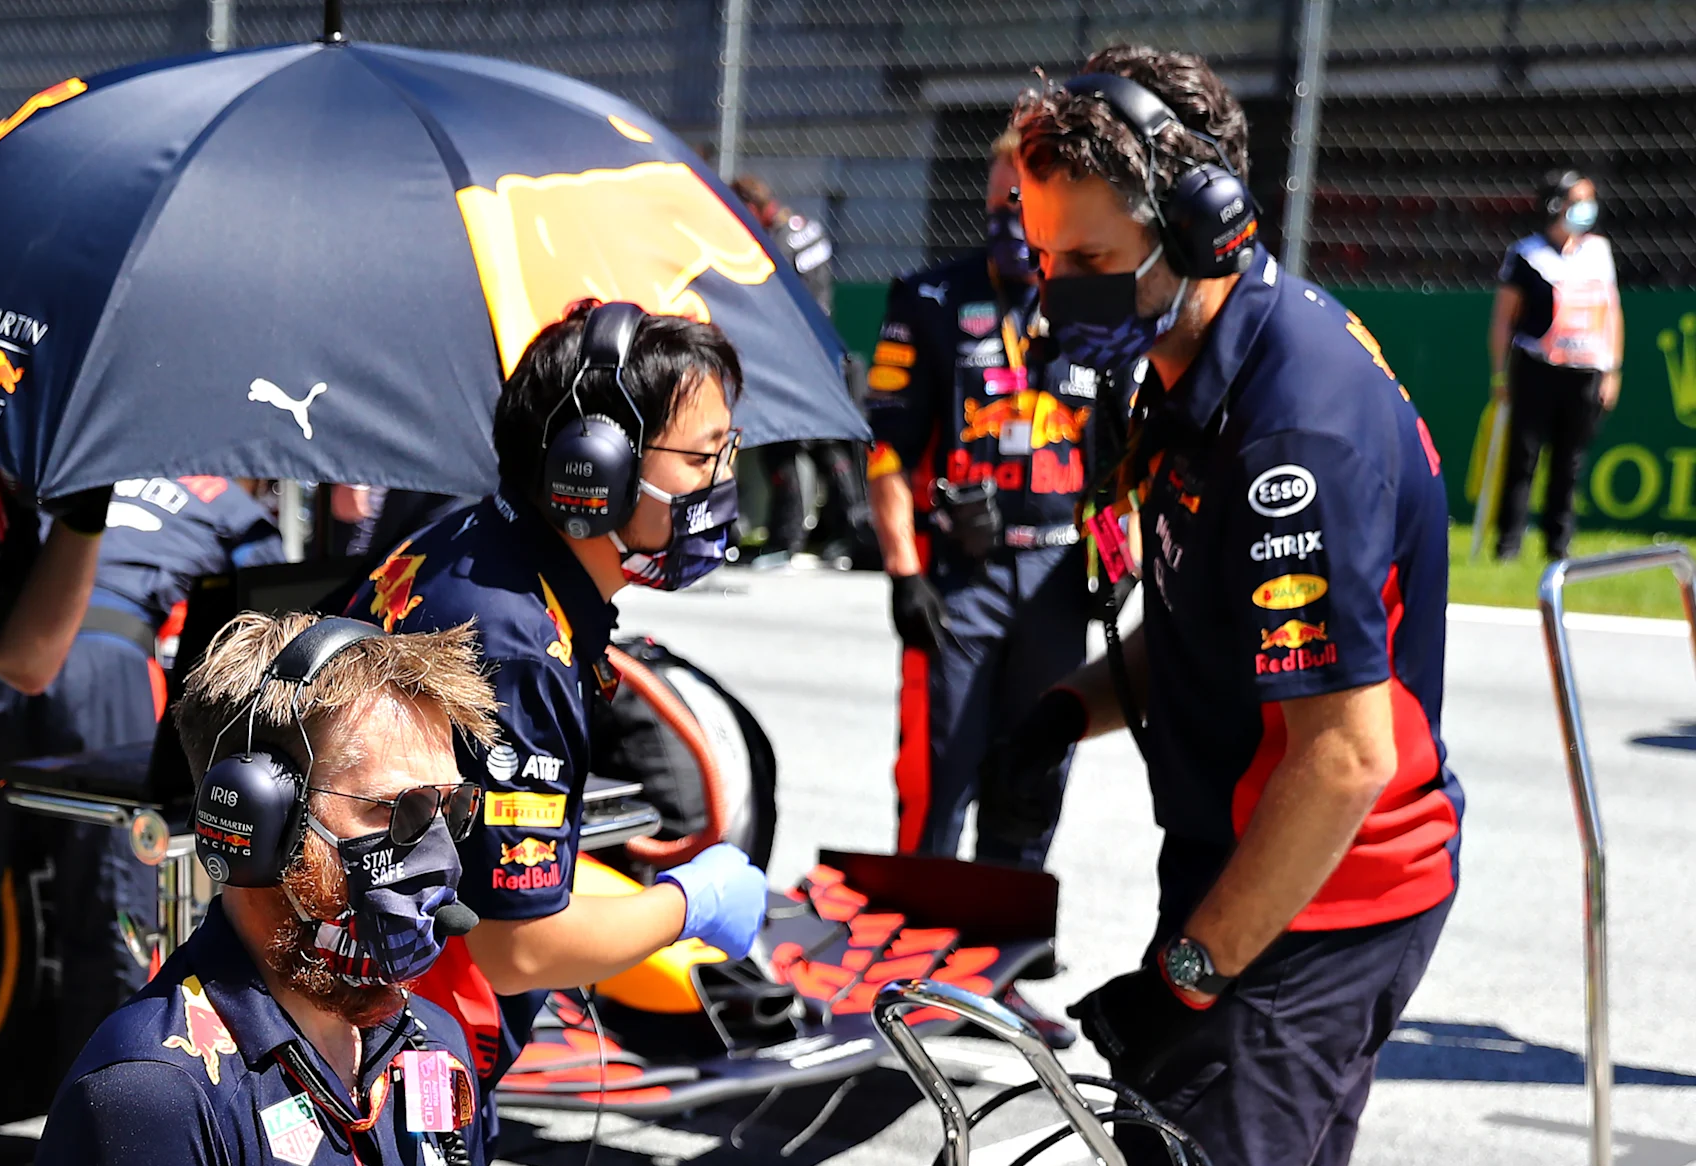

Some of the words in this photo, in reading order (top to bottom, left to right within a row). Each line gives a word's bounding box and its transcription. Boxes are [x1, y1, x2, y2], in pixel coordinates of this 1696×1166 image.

[565, 461, 594, 478] IRIS
[1255, 647, 1297, 676] Red
[1297, 642, 1338, 671] Bull
[210, 785, 239, 808] IRIS
[494, 800, 557, 819] PIRELLI
[219, 817, 254, 833] MARTIN
[362, 847, 394, 871] STAY
[370, 861, 406, 886] SAFE
[492, 867, 532, 890] Red
[531, 863, 561, 889] Bull
[422, 1079, 435, 1126] GRID
